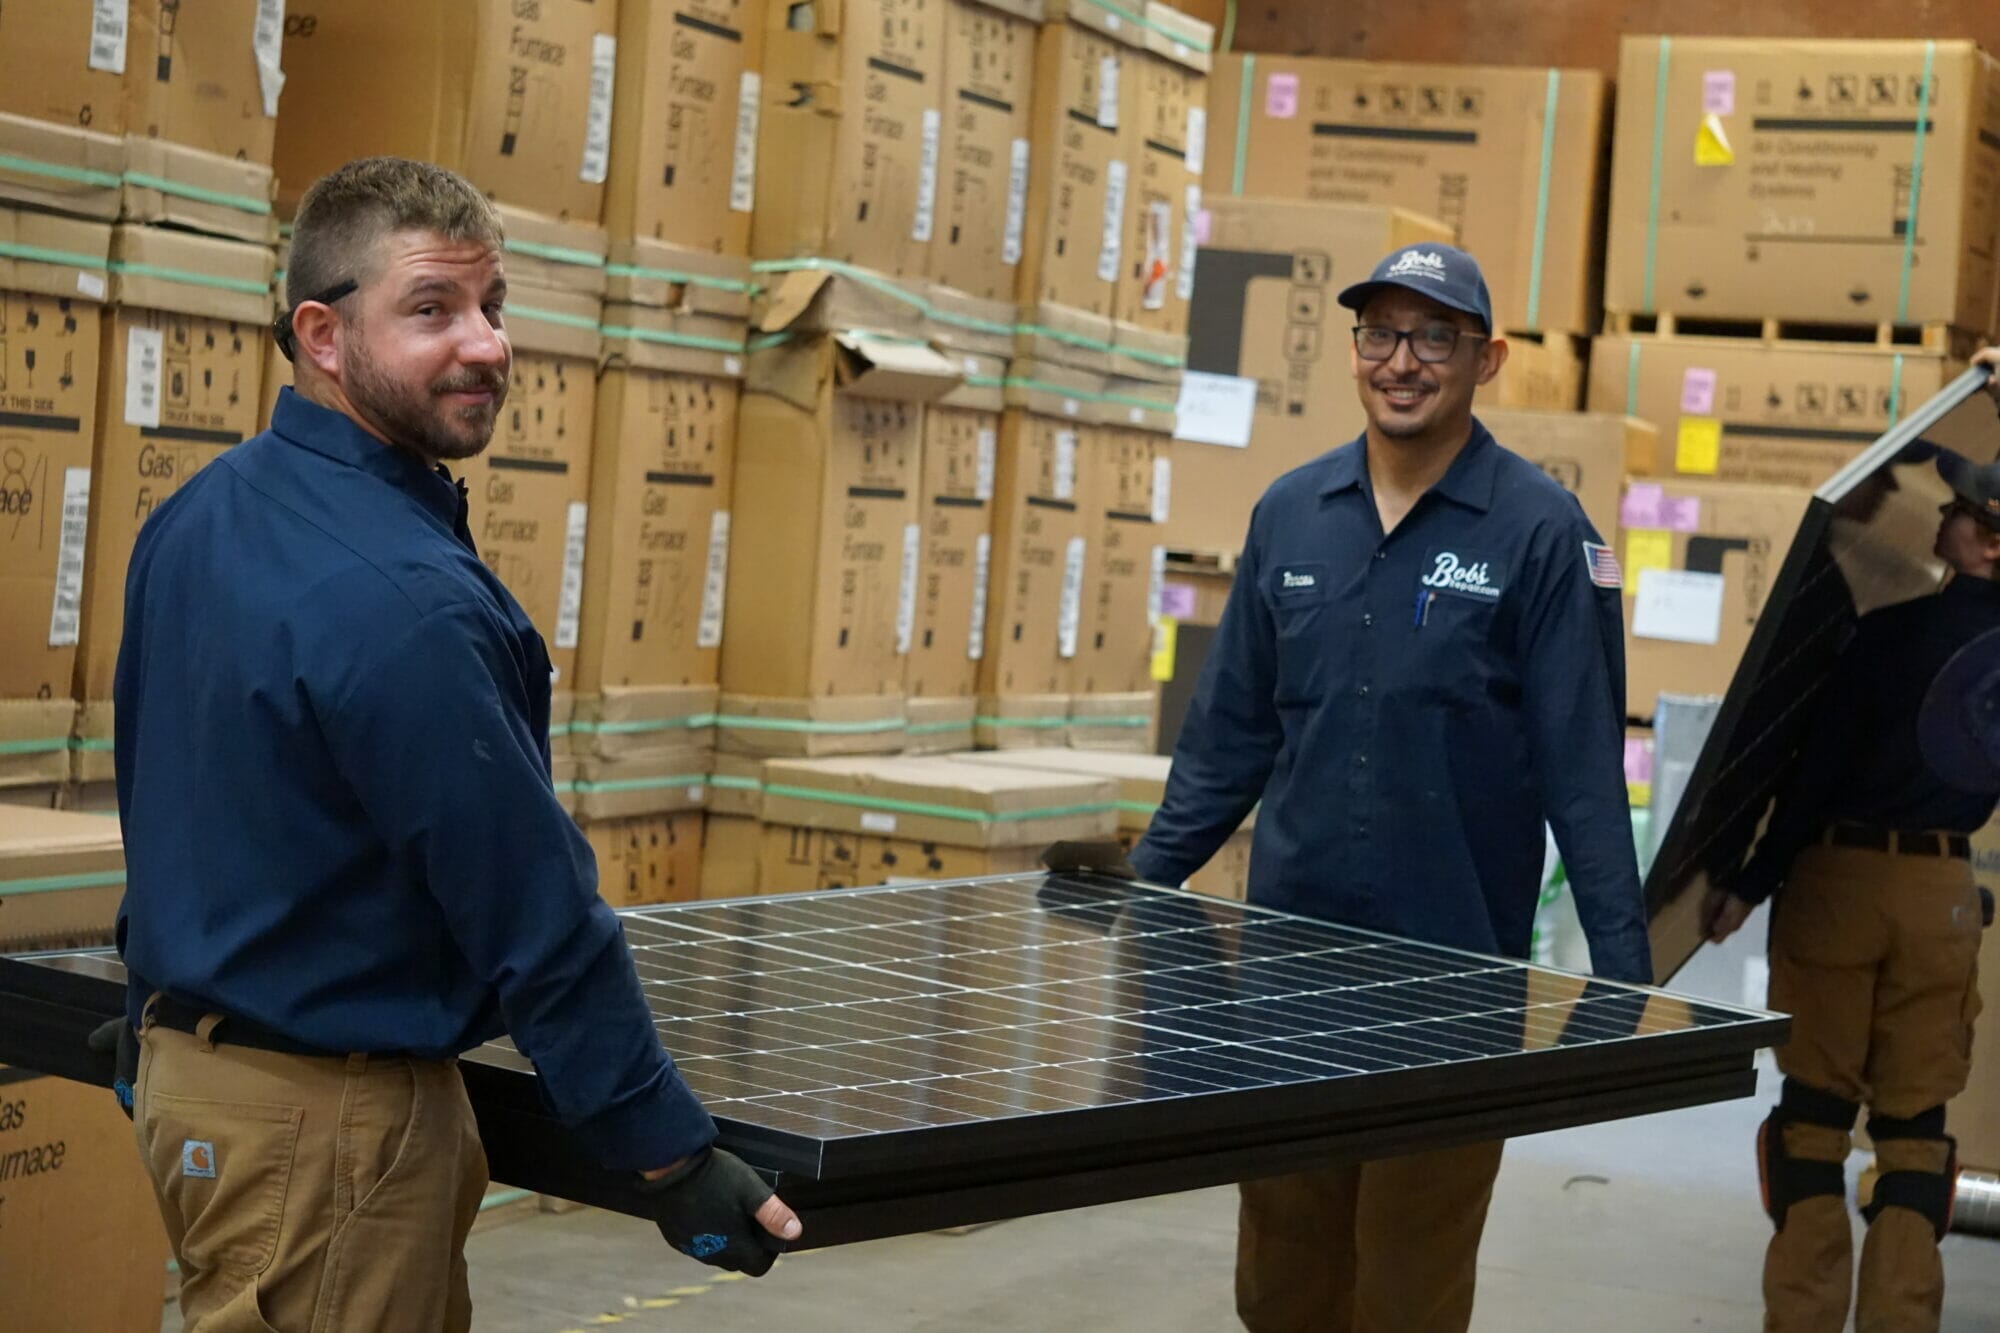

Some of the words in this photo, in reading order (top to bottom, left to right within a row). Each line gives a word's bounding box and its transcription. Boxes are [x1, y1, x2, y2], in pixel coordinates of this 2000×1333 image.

[138, 443, 175, 479] Gas
[486, 473, 516, 505] Gas
[482, 509, 540, 542] Furnace
[1422, 551, 1490, 587] Bob's
[0, 1097, 26, 1132] as
